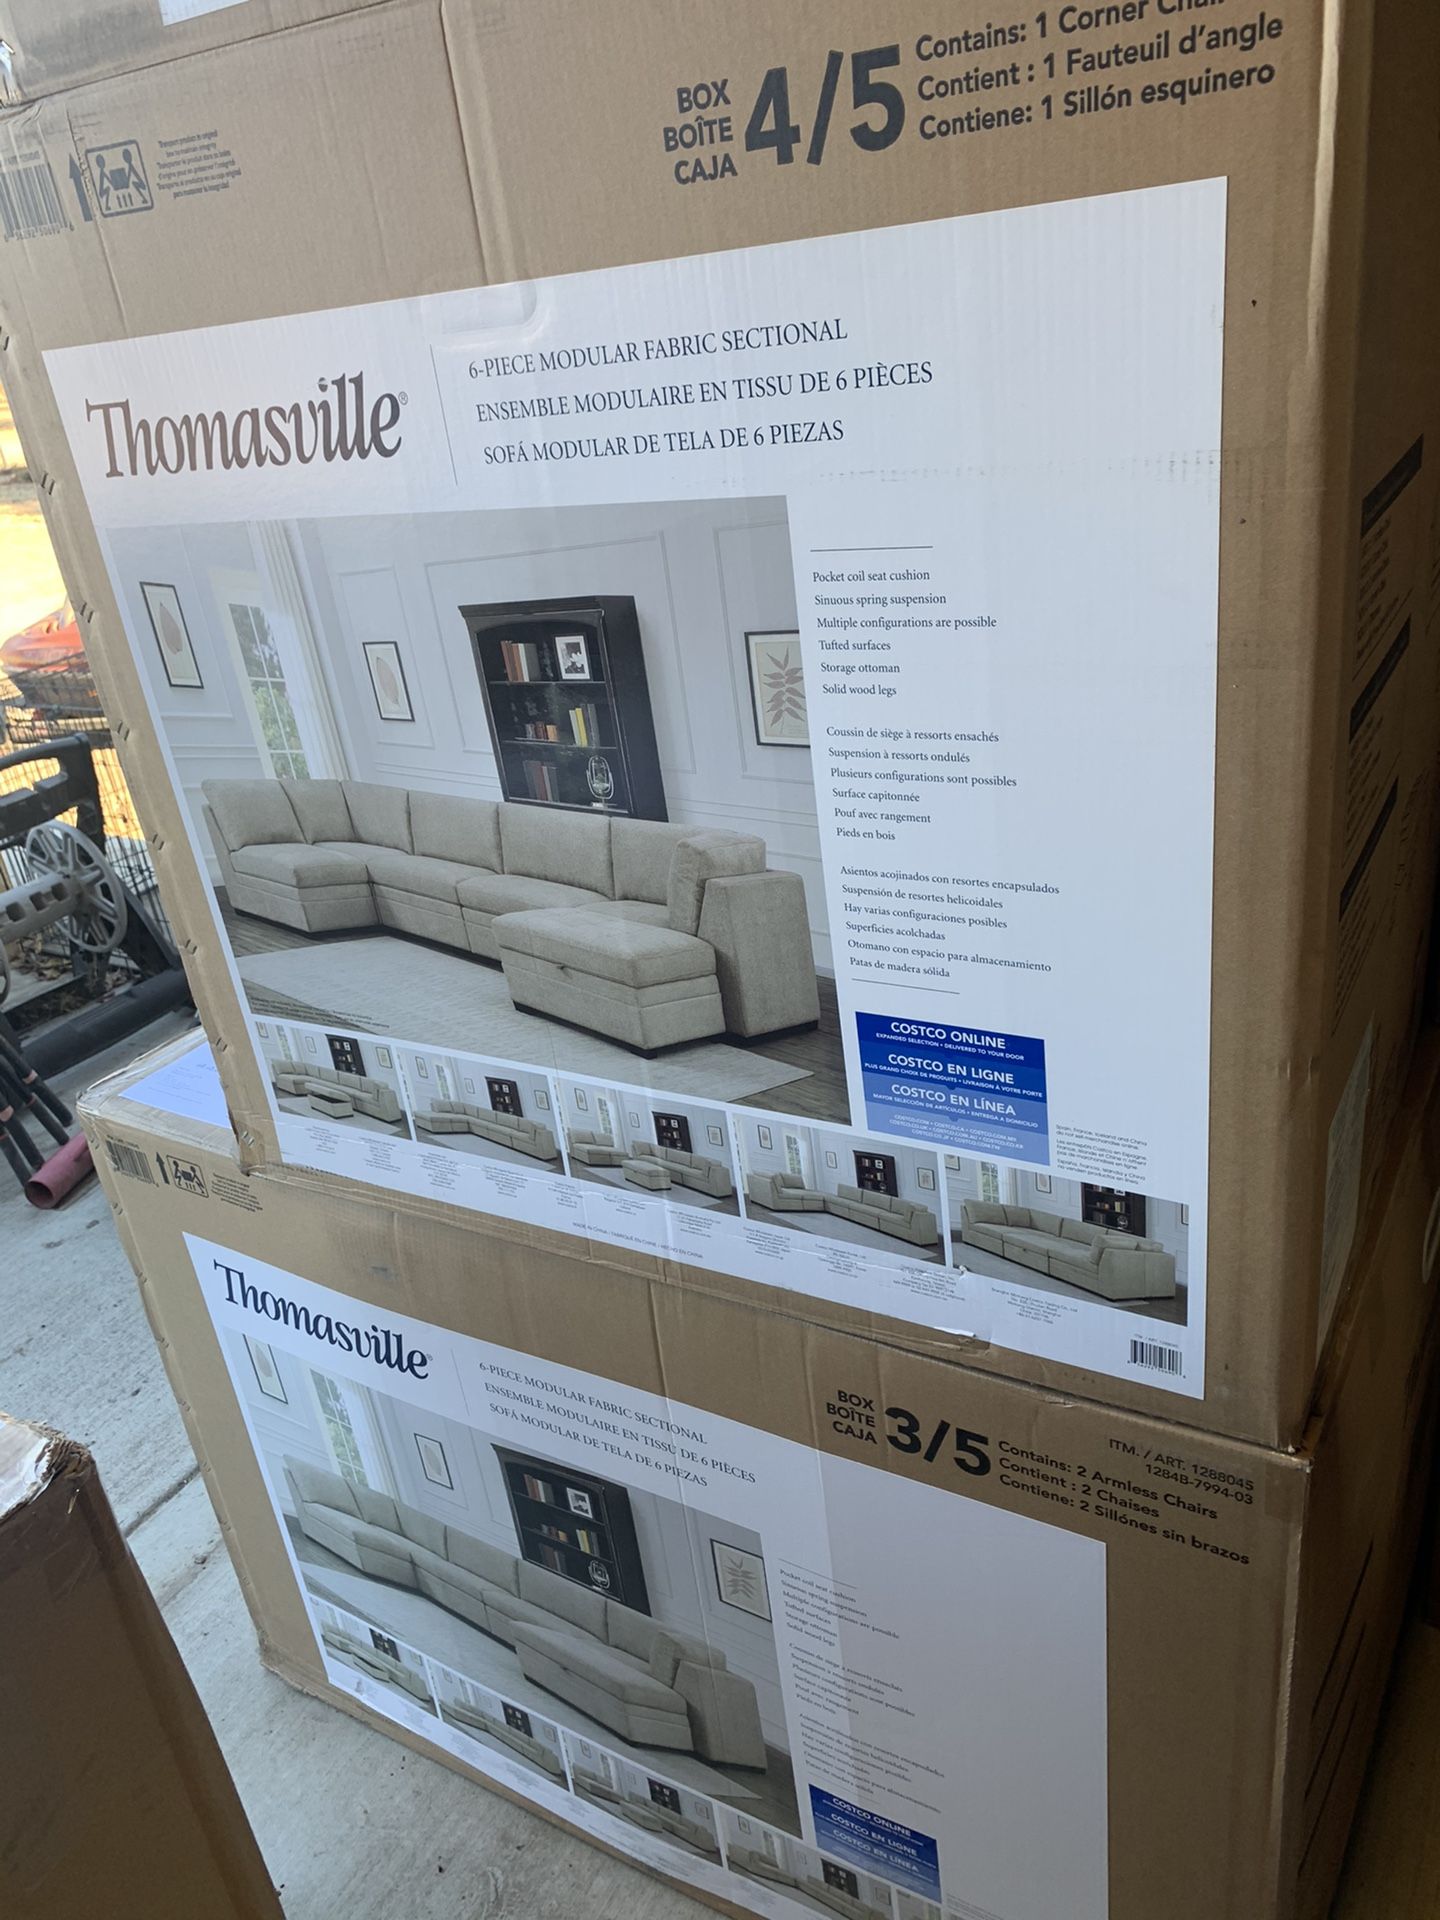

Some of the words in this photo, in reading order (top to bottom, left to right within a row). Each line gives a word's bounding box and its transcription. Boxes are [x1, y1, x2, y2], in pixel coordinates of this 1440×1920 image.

[915, 21, 1026, 61] Contains:
[1035, 10, 1047, 38] 1
[1057, 0, 1149, 34] Corner
[917, 62, 1020, 101] Contient
[1042, 52, 1054, 78] 1
[1066, 29, 1169, 75] Fauteuil
[1178, 12, 1283, 55] d’angle
[676, 78, 731, 114] BOX
[744, 43, 906, 166] 4/5
[918, 104, 1032, 140] Contiene:
[1040, 94, 1052, 120] 1
[1063, 83, 1132, 117] Sillón
[1140, 63, 1275, 105] esquinero
[663, 115, 734, 152] BOÎTE
[674, 153, 738, 185] CAJA
[468, 353, 535, 378] 6-PIECE
[538, 341, 640, 371] MODULAR
[643, 332, 717, 360] FABRIC
[721, 318, 847, 352] SECTIONAL
[475, 395, 570, 422] ENSEMBLE
[573, 383, 695, 413] MODULAIRE
[698, 380, 727, 402] EN
[731, 374, 792, 399] TISSU
[798, 370, 830, 394] DE
[835, 369, 847, 390] 6
[852, 360, 932, 389] PIÈCES
[85, 371, 402, 478] Thomasville
[483, 440, 529, 464] SOFÁ
[531, 436, 630, 461] MODULAR
[632, 433, 660, 454] DE
[662, 430, 715, 452] TELA
[719, 426, 749, 448] DE
[752, 426, 764, 446] 6
[768, 419, 844, 444] PIEZAS
[812, 570, 845, 582] Pocket
[846, 569, 865, 582] coil
[867, 571, 887, 581] seat
[888, 568, 930, 581] cushion
[814, 594, 854, 605] Sinuous
[855, 593, 888, 608] spring
[889, 592, 946, 607] suspension
[816, 616, 858, 630] Multiple
[859, 615, 933, 630] configurations
[934, 618, 951, 627] are
[953, 615, 997, 630] possible
[817, 639, 850, 650] Tufted
[851, 638, 891, 650] surfaces
[820, 662, 856, 675] Storage
[857, 663, 900, 672] ottoman
[822, 682, 847, 694] Solid
[848, 683, 876, 695] wood
[877, 683, 896, 698] legs
[825, 725, 864, 737] Coussin
[865, 726, 878, 738] de
[879, 727, 903, 741] siège
[905, 729, 911, 739] à
[913, 731, 952, 740] ressorts
[953, 730, 999, 742] ensachés
[828, 746, 881, 760] Suspension
[882, 749, 889, 759] à
[890, 751, 929, 761] ressorts
[929, 751, 970, 763] ondulés
[830, 766, 872, 779] Plusieurs
[873, 769, 944, 783] configurations
[946, 775, 968, 784] sont
[970, 774, 1017, 787] possibles
[831, 787, 866, 799] Surface
[867, 790, 920, 802] capitonnée
[834, 807, 856, 818] Pouf
[857, 811, 878, 819] avec
[879, 812, 931, 824] rangement
[836, 826, 861, 838] Pieds
[874, 829, 896, 840] bois
[840, 865, 878, 877] Asientos
[879, 870, 930, 882] acojinados
[930, 875, 949, 884] con
[951, 877, 989, 887] resortes
[991, 881, 1060, 894] encapsulados
[841, 883, 892, 897] Suspensión
[894, 888, 906, 899] de
[907, 892, 944, 902] resortes
[946, 893, 1003, 908] helicoidales
[843, 902, 862, 915] Hay
[863, 905, 890, 915] varias
[891, 908, 966, 924] configuraciones
[967, 916, 1007, 928] posibles
[844, 920, 894, 934] Superficies
[895, 927, 945, 940] acolchadas
[847, 938, 890, 952] Otomano
[891, 946, 909, 954] con
[910, 948, 945, 959] espacio
[946, 952, 968, 962] para
[970, 953, 1051, 971] almacenamiento
[849, 956, 872, 967] Patas
[873, 959, 885, 969] de
[886, 962, 920, 974] madera
[922, 966, 950, 977] sólida
[890, 1021, 946, 1039] COSTCO
[950, 1030, 1006, 1049] ONLINE
[887, 1053, 943, 1072] COSTCO
[946, 1062, 967, 1076] EN
[970, 1066, 1014, 1084] LIGNE
[890, 1083, 946, 1102] COSTCO
[949, 1093, 969, 1107] EN
[973, 1096, 1016, 1115] LÍNEA
[214, 1259, 429, 1380] Thomasville
[478, 1362, 522, 1383] 6-PIECE
[523, 1375, 586, 1403] MODULAR
[587, 1396, 632, 1419] FABRIC
[633, 1411, 707, 1444] SECTIONAL
[826, 1402, 877, 1428] BOÎTE
[837, 1389, 876, 1412] BOX
[484, 1382, 544, 1409] ENSEMBLE
[545, 1402, 620, 1435] MODULAIRE
[621, 1427, 639, 1442] EN
[679, 1447, 699, 1463] DE
[700, 1456, 708, 1466] 6
[832, 1420, 878, 1445] CAJA
[884, 1406, 992, 1477] 3/5
[997, 1440, 1071, 1472] Contains:
[1076, 1464, 1087, 1478] 2
[1090, 1470, 1158, 1500] Armless
[1162, 1492, 1217, 1519] Chairs
[1108, 1437, 1140, 1456] ITM.
[1153, 1452, 1186, 1471] ART.
[1191, 1463, 1254, 1491] 1288045
[998, 1456, 1066, 1488] Contient
[1080, 1483, 1091, 1496] 2
[1096, 1488, 1159, 1517] Chaises
[1145, 1463, 1253, 1504] 1284B-7994-03
[999, 1473, 1074, 1507] Contiene:
[1079, 1499, 1089, 1512] 2
[1093, 1504, 1157, 1534] Sillónes
[1161, 1528, 1185, 1544] sin
[1190, 1534, 1249, 1564] brazos
